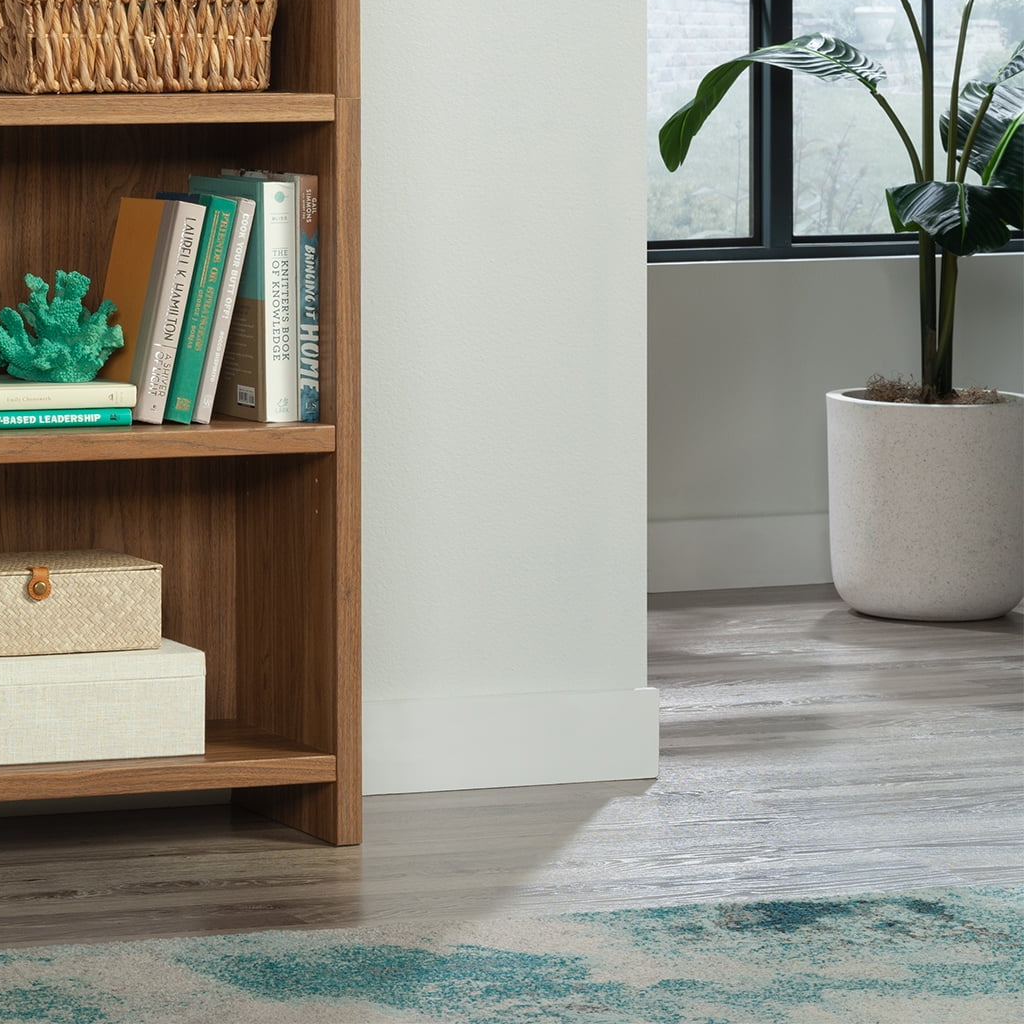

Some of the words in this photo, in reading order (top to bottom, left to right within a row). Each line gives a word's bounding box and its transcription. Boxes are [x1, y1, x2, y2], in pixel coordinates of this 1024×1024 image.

[177, 217, 196, 264] LAURELL
[213, 212, 230, 263] FRIENDS
[238, 213, 249, 239] COOK
[232, 242, 244, 267] YOUR
[272, 260, 280, 276] OF
[208, 267, 218, 282] OR
[228, 270, 238, 294] BUTT
[305, 244, 316, 302] BRINGING
[194, 289, 204, 316] GEORGE
[281, 260, 289, 322] KNITTER'S
[163, 282, 184, 341] HAMILTON
[194, 286, 214, 351] STRANGERS
[222, 297, 232, 320] OFF!
[272, 281, 281, 361] KNOWLEDGE
[305, 306, 316, 320] IT
[154, 351, 164, 365] OF
[281, 327, 290, 361] BOOK
[300, 324, 319, 392] HOME
[149, 367, 161, 396] LIGHT
[158, 363, 172, 397] SHIVER
[39, 413, 102, 424] LEADERSHIP
